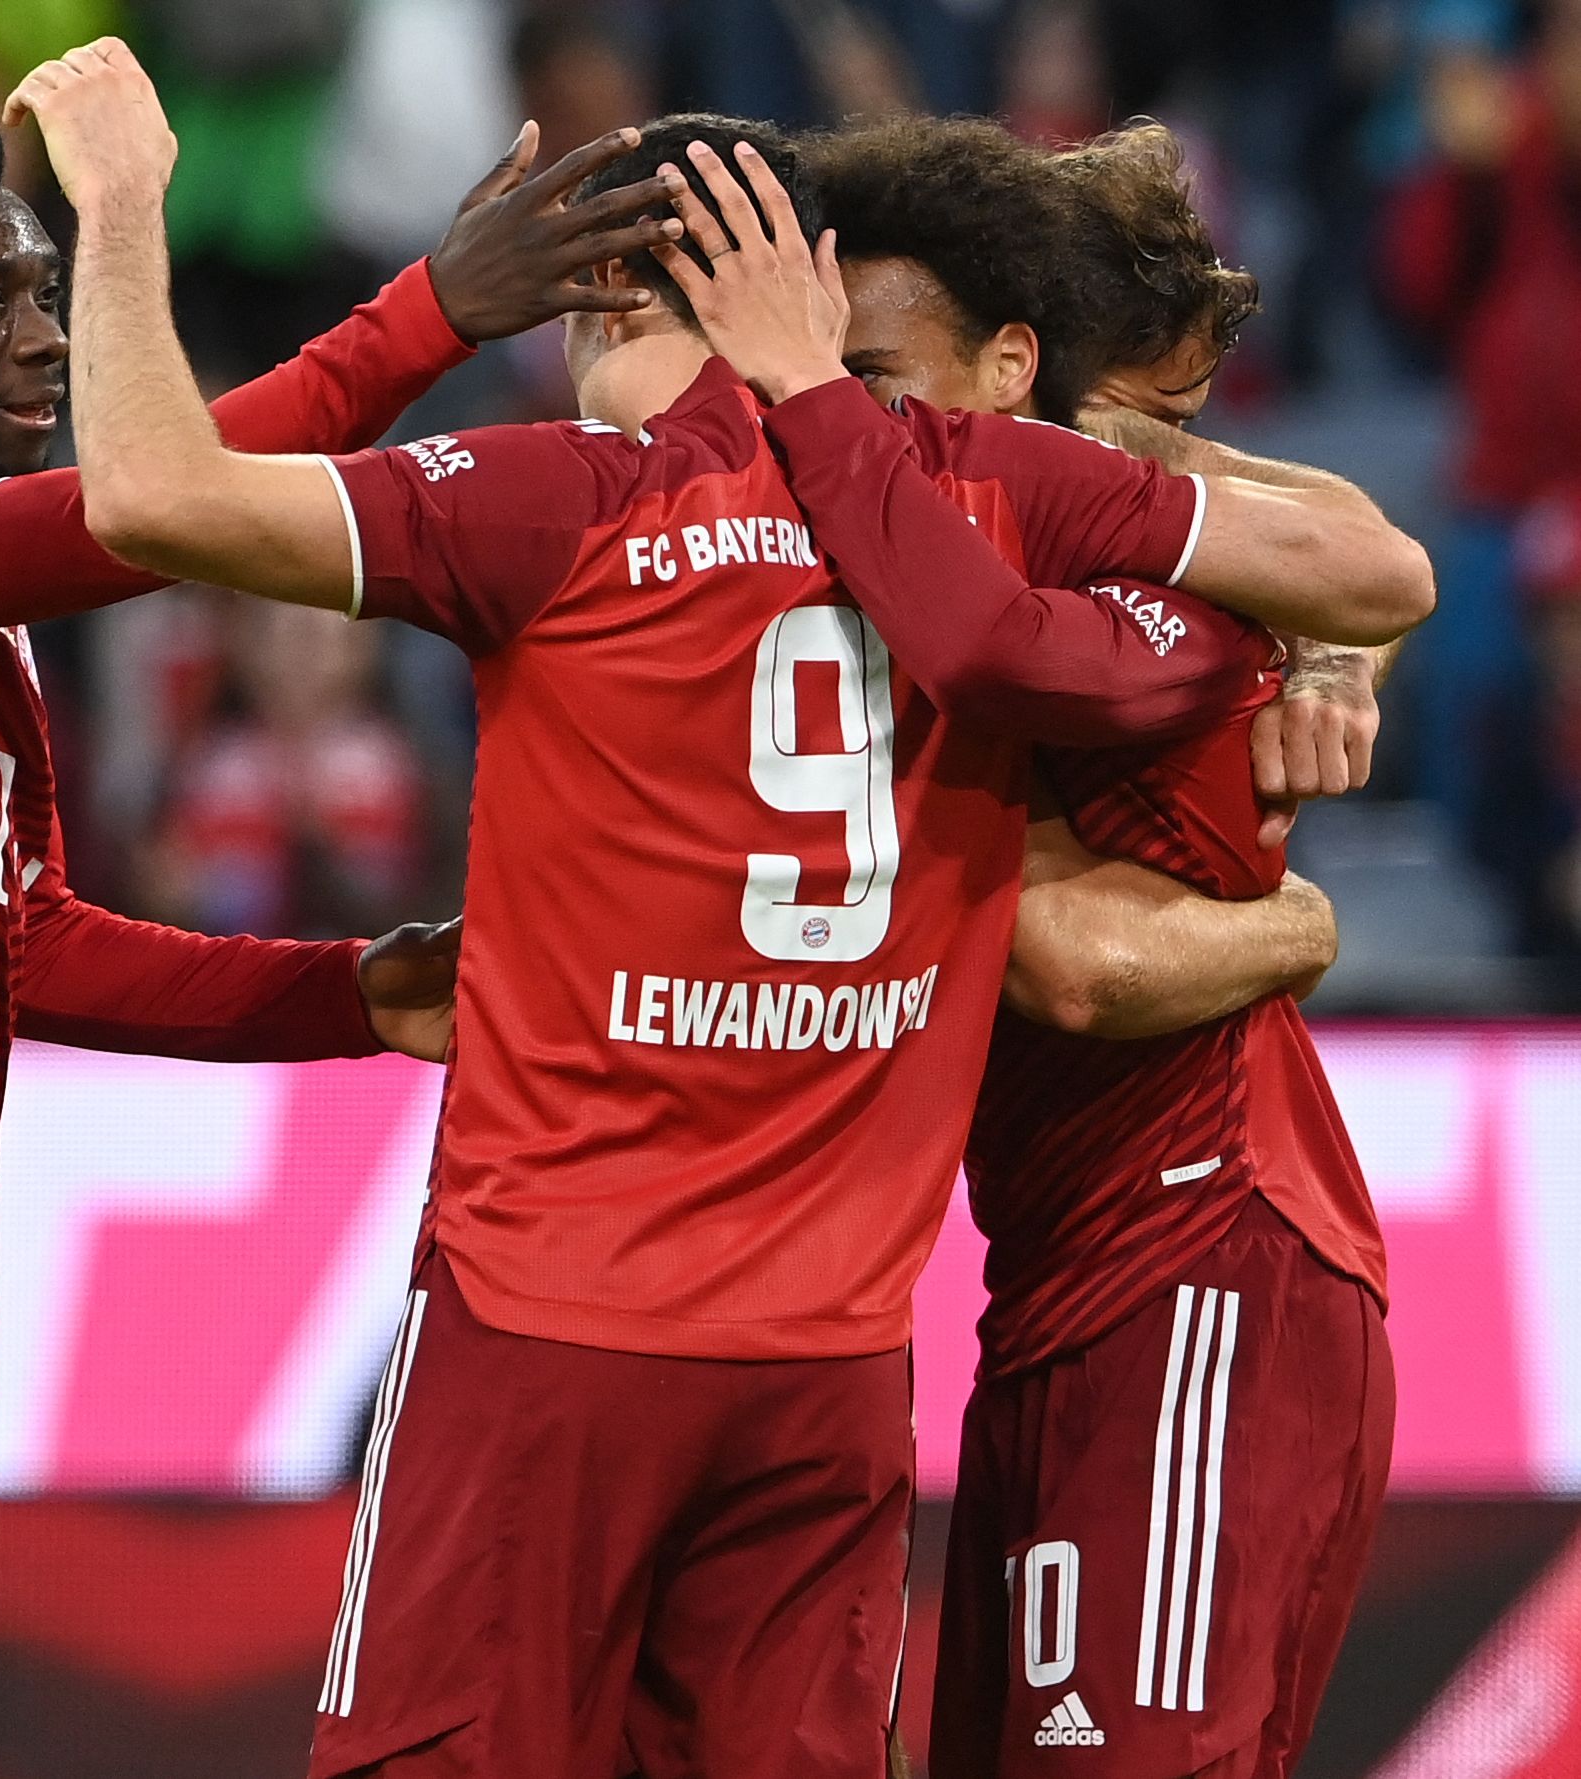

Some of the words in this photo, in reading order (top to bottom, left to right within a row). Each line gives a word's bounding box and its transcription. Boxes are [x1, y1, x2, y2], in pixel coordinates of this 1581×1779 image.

[417, 435, 475, 476] TAR
[625, 533, 677, 586] FC
[681, 516, 818, 572] BAYERN
[739, 605, 901, 962] 9
[607, 964, 939, 1052] LEWANDOWSI
[1034, 1725, 1106, 1747] adidas
